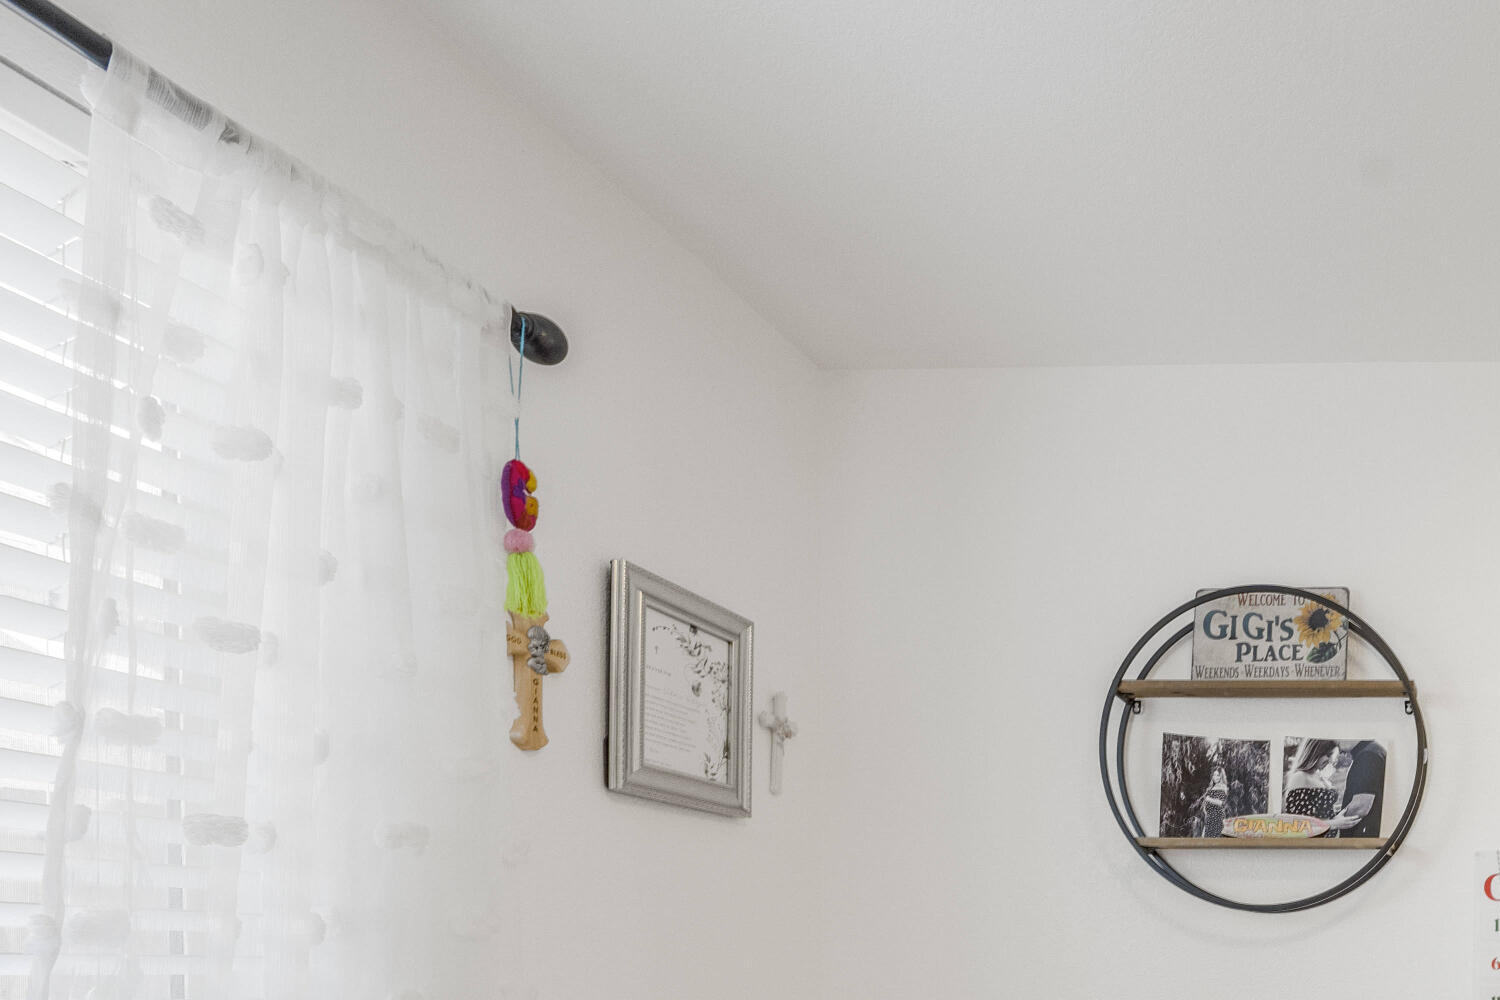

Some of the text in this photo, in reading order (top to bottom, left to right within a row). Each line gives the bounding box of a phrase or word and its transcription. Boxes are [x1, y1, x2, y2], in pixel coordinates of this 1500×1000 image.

[1237, 592, 1286, 606] WELCOME
[1235, 642, 1304, 663] PLACE
[1195, 665, 1239, 679] WEEKENDS
[1244, 664, 1290, 678] WEEKDAYS
[1494, 918, 1500, 932] 1
[1491, 957, 1500, 970] 6
